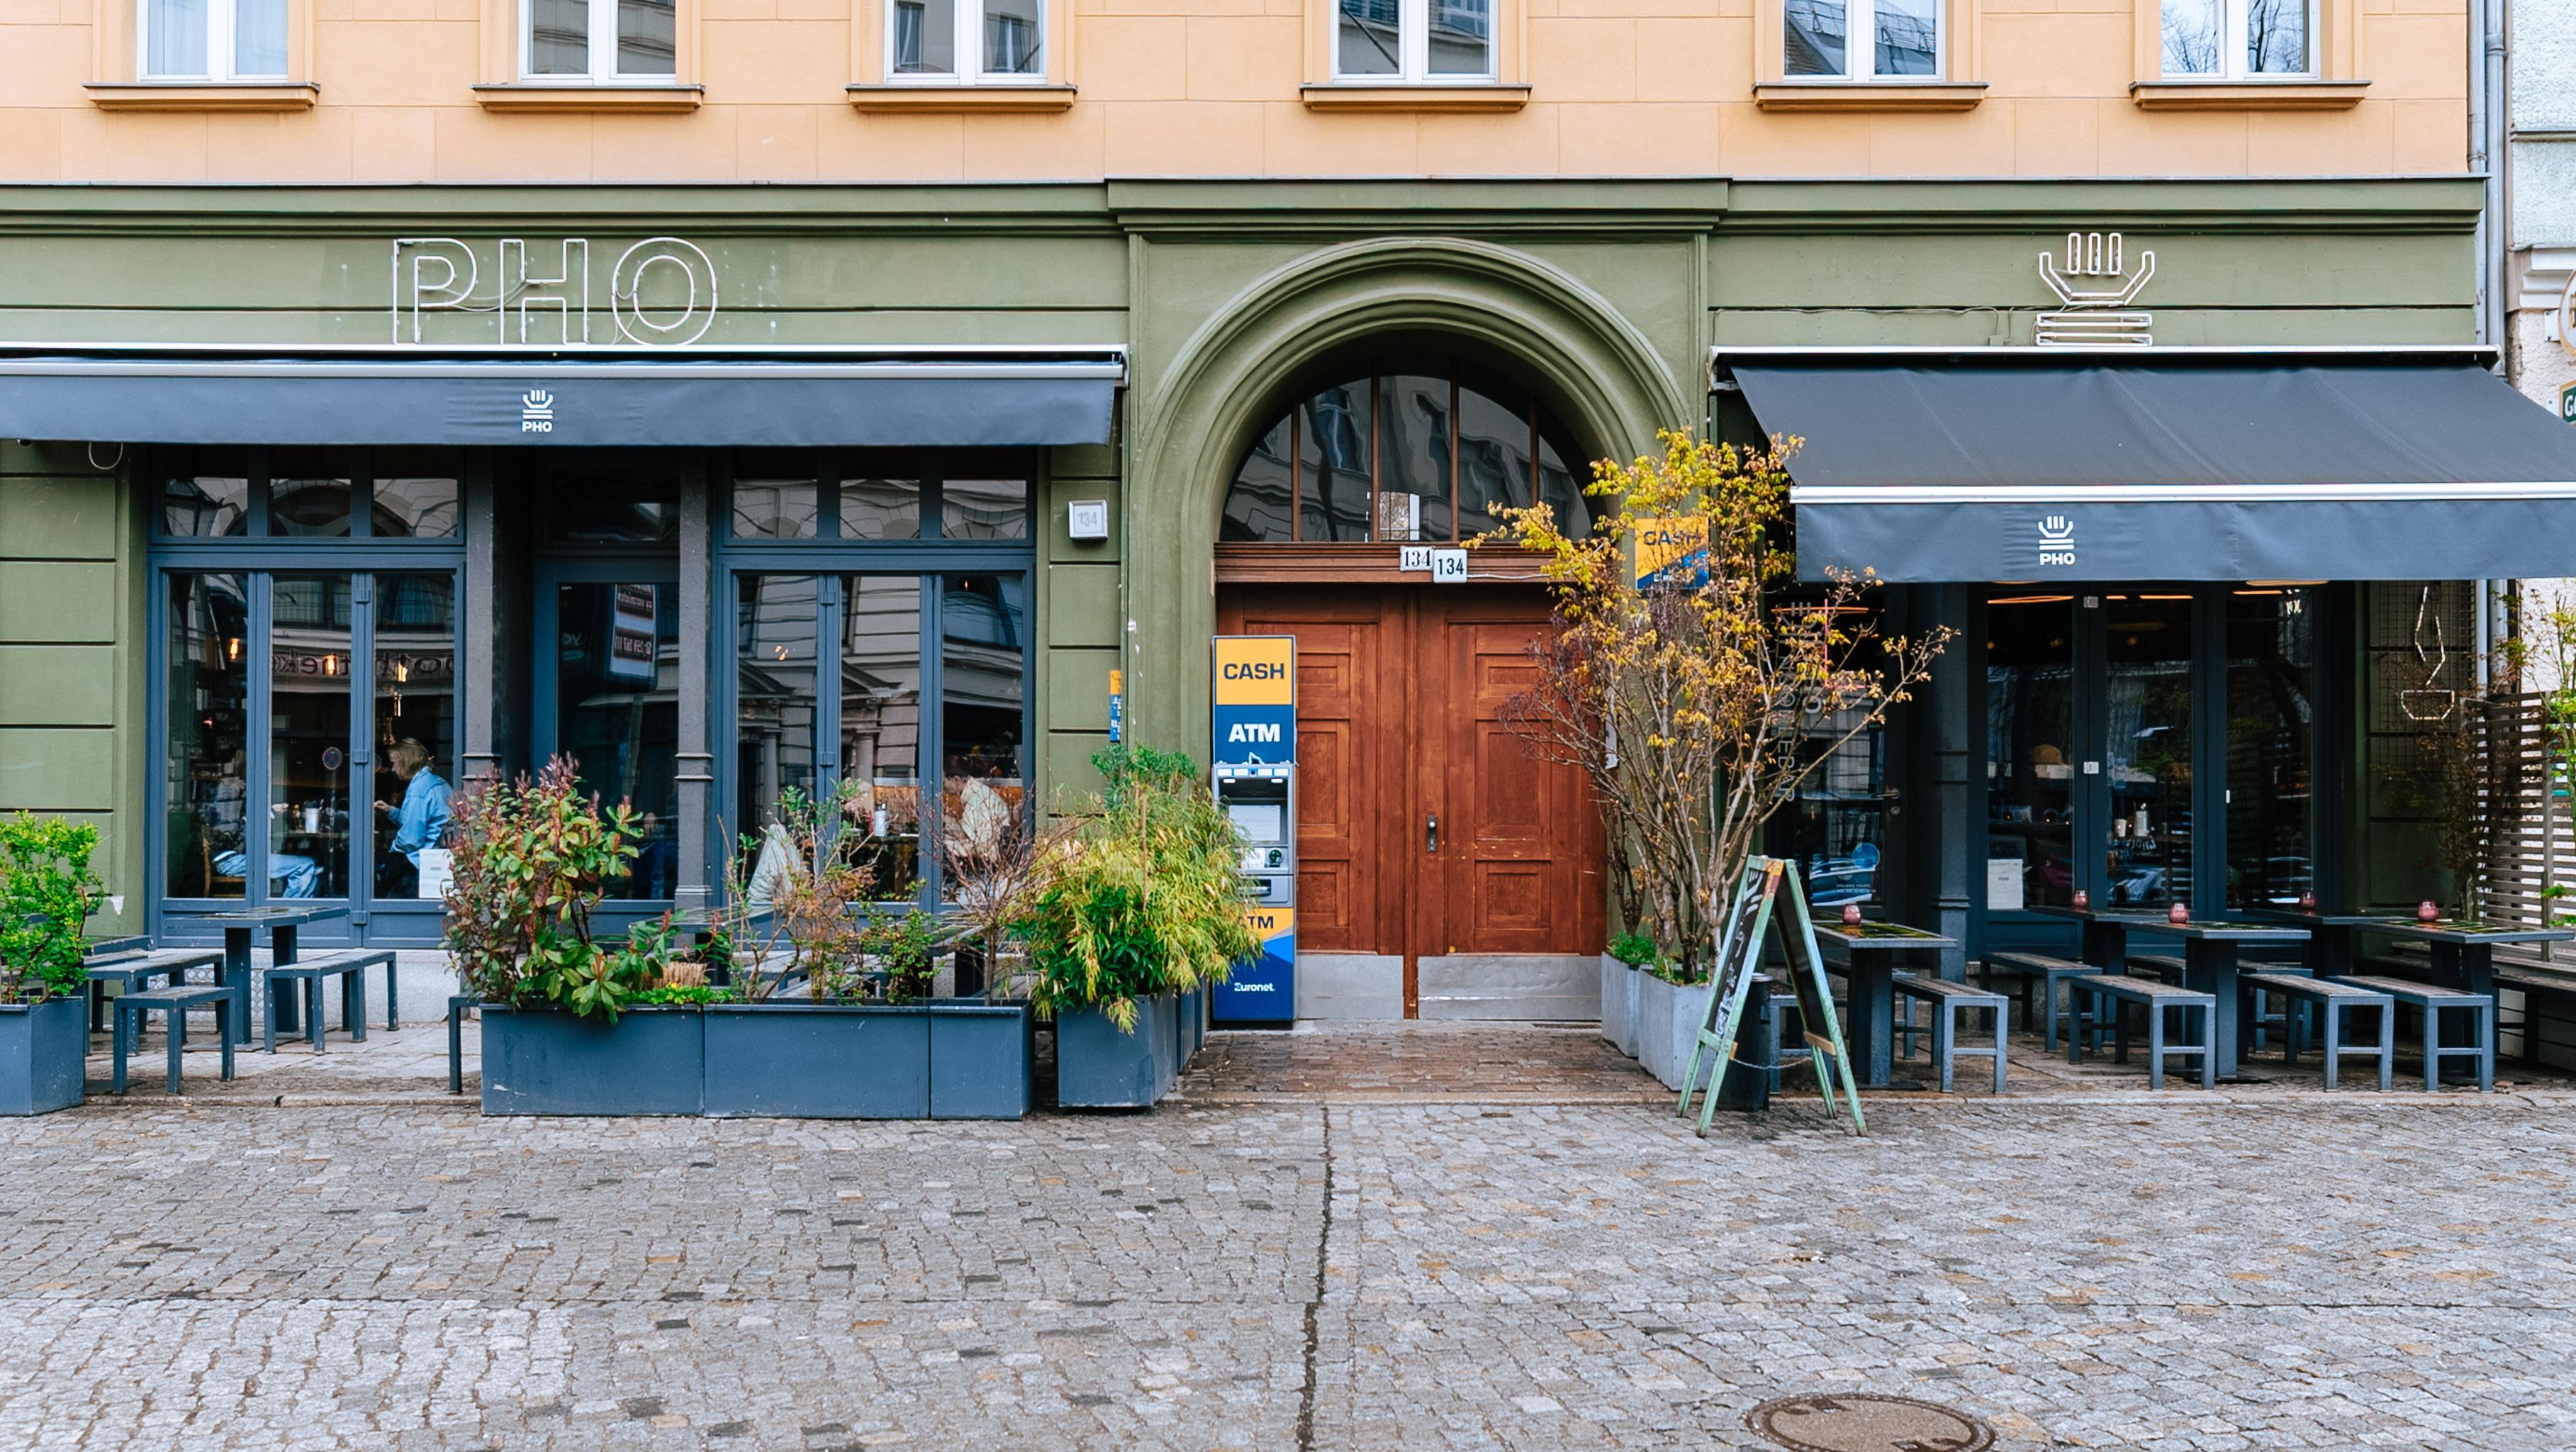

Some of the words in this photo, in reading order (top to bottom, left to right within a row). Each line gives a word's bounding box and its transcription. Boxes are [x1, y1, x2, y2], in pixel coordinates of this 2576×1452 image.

[393, 237, 719, 346] PHO
[522, 420, 553, 432] PHO
[1077, 511, 1097, 527] 134
[1405, 549, 1430, 567] 134
[1438, 557, 1464, 575] 134
[2039, 552, 2076, 565] PHO
[1223, 662, 1284, 680] CASH
[1228, 723, 1280, 742] ATM
[1236, 915, 1274, 929] TM
[1234, 982, 1274, 992] Euronet
